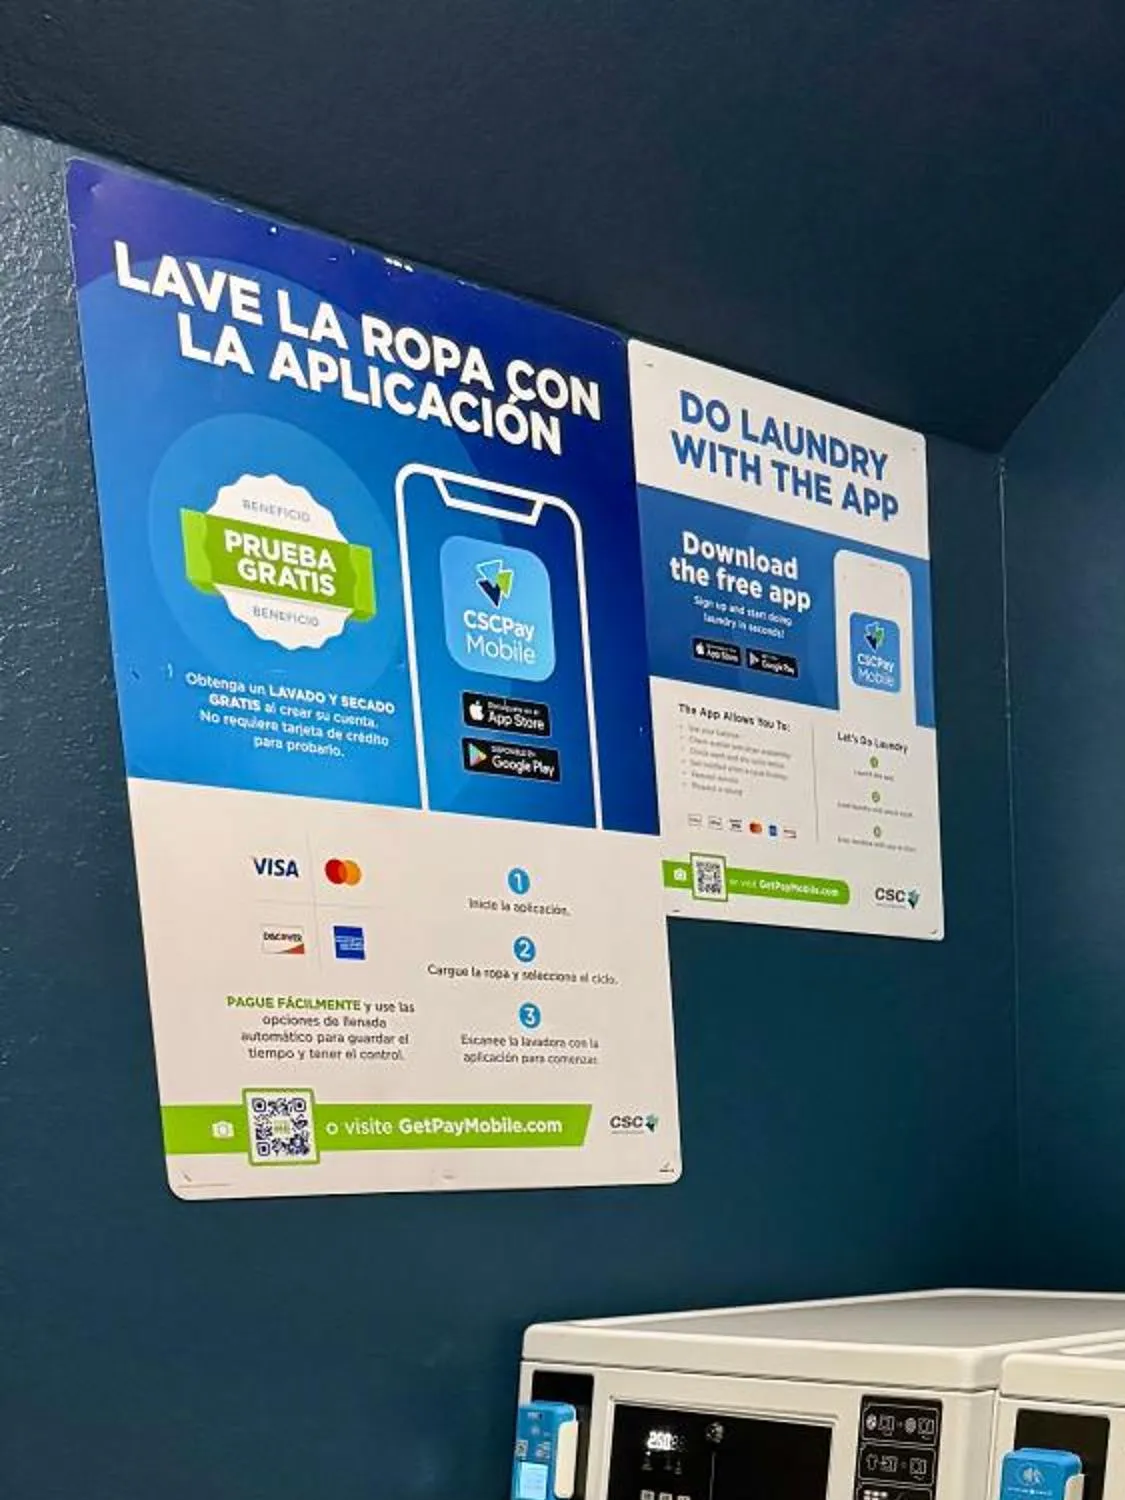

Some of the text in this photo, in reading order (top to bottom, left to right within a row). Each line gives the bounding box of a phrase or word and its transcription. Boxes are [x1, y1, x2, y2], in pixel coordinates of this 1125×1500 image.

[112, 240, 602, 421] LAVE LA ROPA CON
[177, 312, 563, 456] LA APLICACIÓN
[679, 389, 888, 482] DO LAUNDRY
[670, 429, 899, 522] WITH THE APP
[242, 499, 310, 523] BENEFICIO
[224, 529, 337, 573] PRUEBA
[682, 530, 798, 581] Download
[237, 557, 336, 597] GRATIS
[669, 556, 811, 613] the free app
[253, 605, 320, 628] BENEFICIO
[729, 604, 745, 615] and
[463, 609, 535, 642] CSCPay
[703, 612, 737, 629] laundry
[738, 619, 747, 630] in
[466, 634, 536, 666] Mobile
[858, 666, 895, 687] Mobile
[185, 671, 396, 715] Obtenga un LAVADO Y SECADO
[208, 692, 262, 712] GRATIS
[264, 702, 277, 714] al
[279, 705, 312, 719] crear
[316, 710, 331, 722] su
[679, 703, 697, 715] The
[700, 707, 720, 720] App
[723, 711, 755, 725] Allows
[200, 710, 220, 723] No
[282, 720, 323, 738] tarjeta
[327, 727, 343, 741] de
[346, 730, 390, 748] crédito
[488, 711, 545, 731] App Store
[253, 735, 346, 758] para probarlo.
[491, 755, 555, 778] Google Play
[253, 857, 299, 878] VISA
[514, 873, 523, 892] 1
[875, 886, 906, 902] CSC
[501, 899, 511, 912] la
[518, 939, 531, 960] 2
[427, 964, 469, 979] Cargue
[471, 966, 482, 978] la
[484, 968, 510, 981] ropa
[512, 970, 519, 982] y
[579, 971, 589, 983] el
[591, 973, 619, 986] ciclo.
[226, 995, 415, 1014] PAGUE FÁCILMENTE y use las
[262, 1014, 320, 1028] opciones
[323, 1014, 340, 1028] de
[524, 1006, 536, 1026] 3
[241, 1030, 409, 1047] automático para guardar el
[509, 1035, 519, 1047] la
[521, 1035, 566, 1049] lavadora
[568, 1038, 588, 1050] con
[590, 1037, 599, 1049] la
[248, 1046, 296, 1062] tiempo
[299, 1050, 306, 1061] y
[309, 1049, 343, 1061] tener
[345, 1048, 357, 1061] el
[463, 1050, 519, 1065] aplicación
[521, 1053, 546, 1066] para
[326, 1115, 563, 1137] o visite GetPayMobile.com
[609, 1115, 643, 1129] CSC
